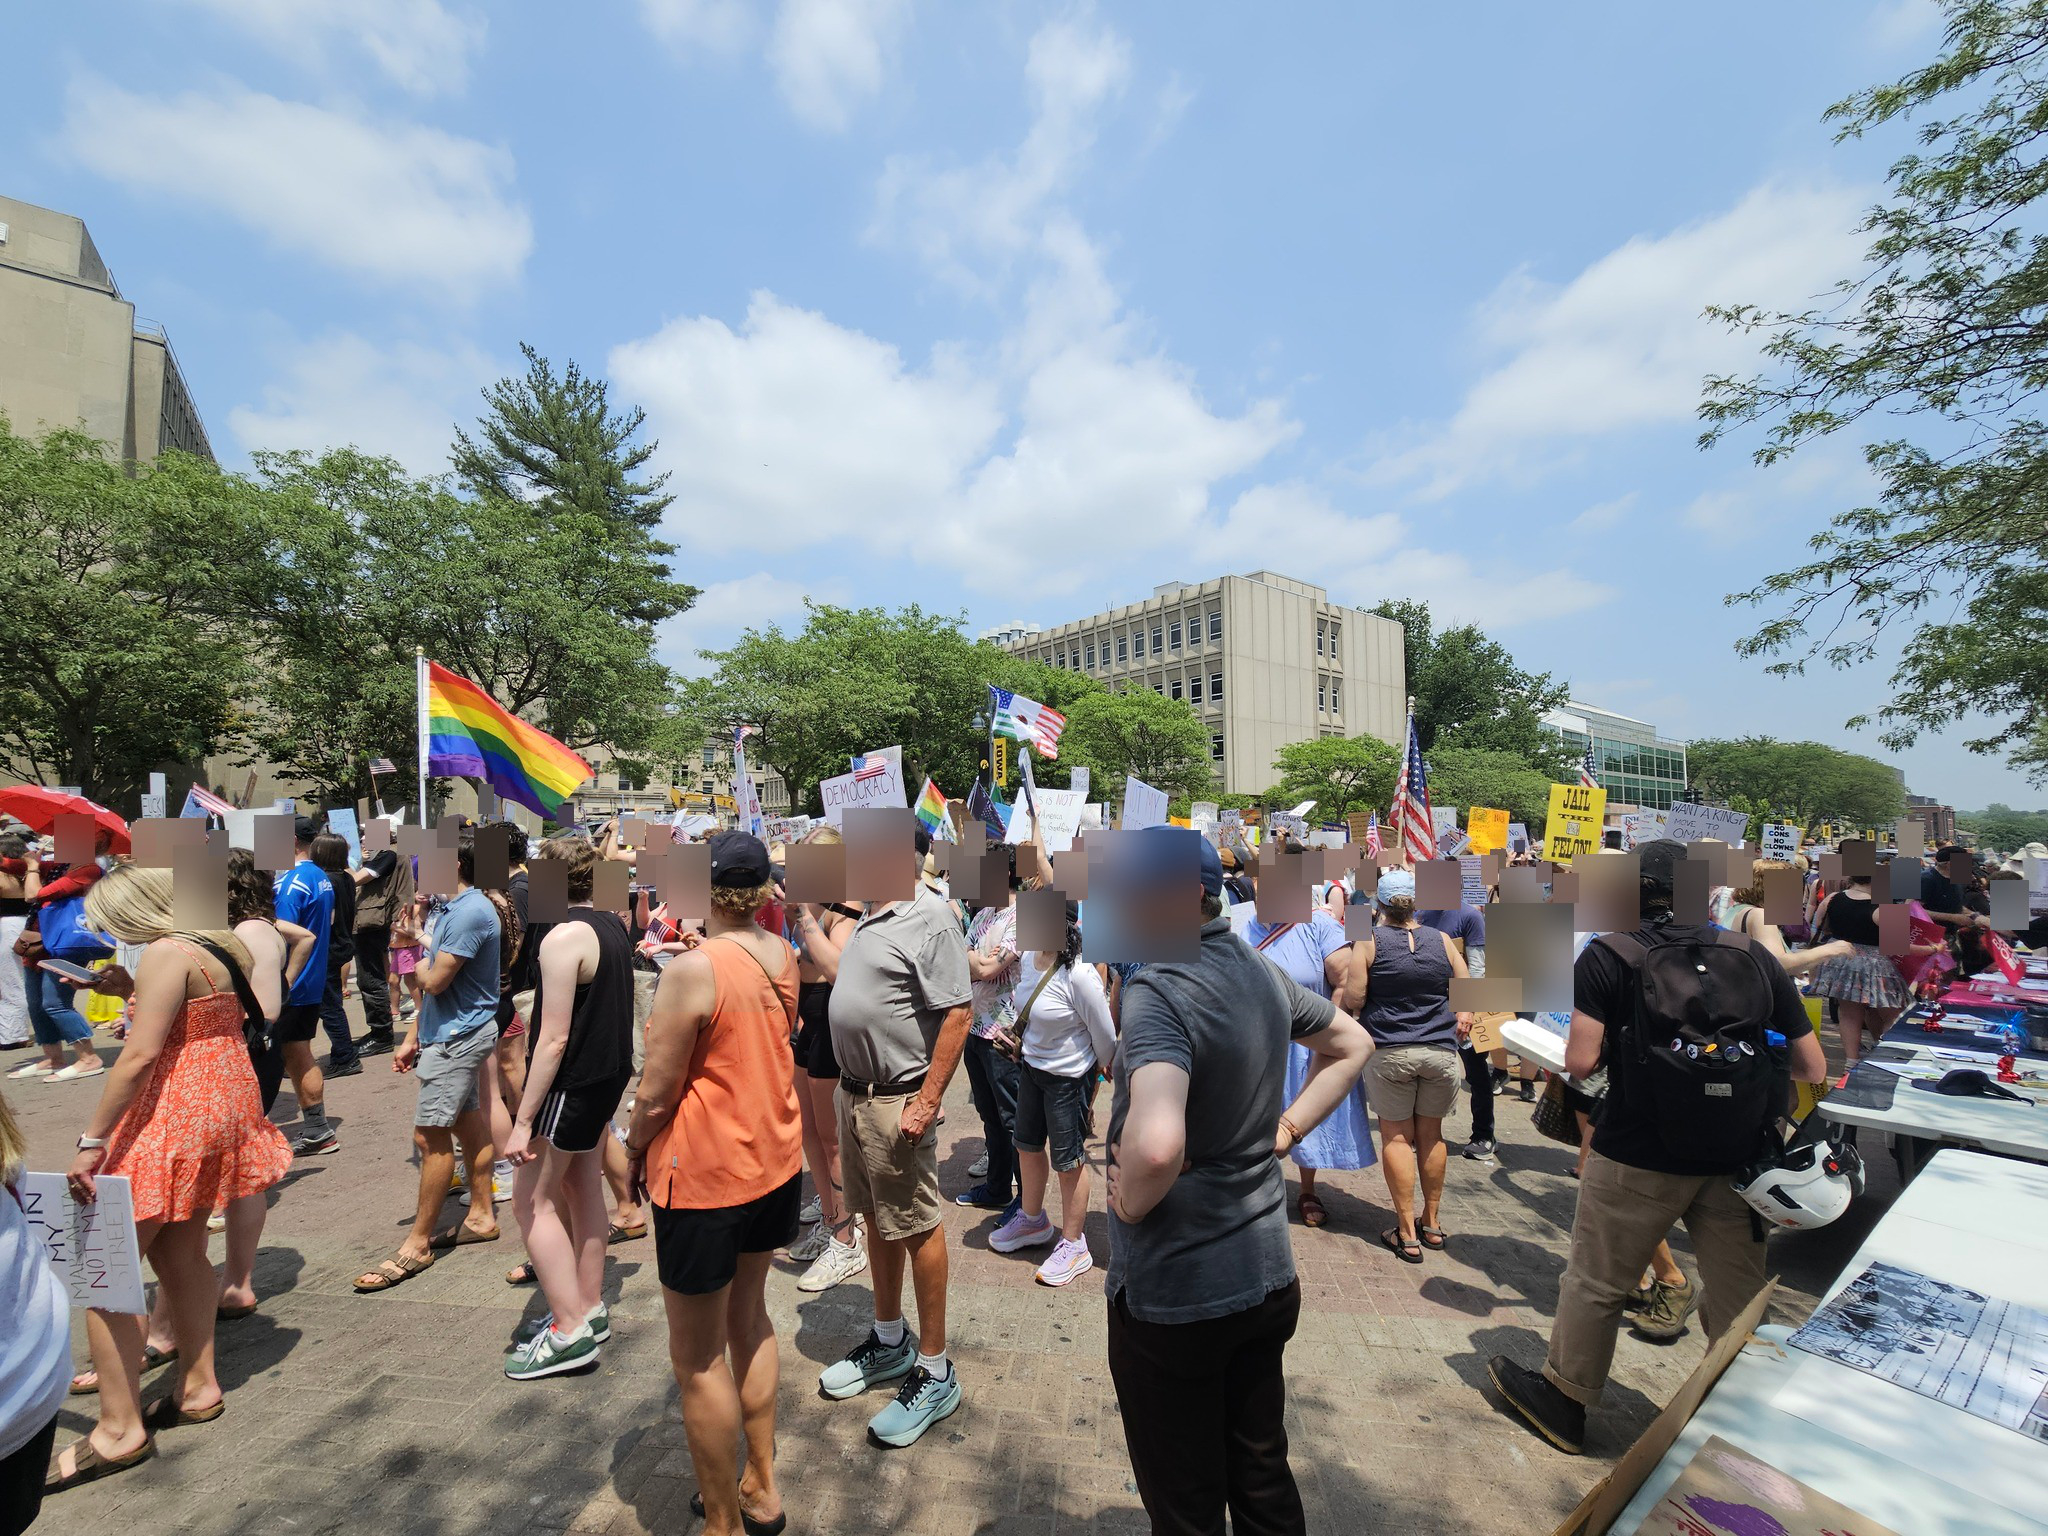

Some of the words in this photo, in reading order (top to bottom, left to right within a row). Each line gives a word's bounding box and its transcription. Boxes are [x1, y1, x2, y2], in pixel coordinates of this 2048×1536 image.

[825, 769, 897, 806] DEMOCRACY
[1056, 794, 1078, 806] NOT
[1562, 788, 1591, 812] JAIL
[1558, 813, 1594, 822] THE
[1671, 801, 1698, 818] WANT
[1700, 808, 1710, 820] A
[1712, 809, 1749, 826] KING?
[1674, 818, 1696, 828] MOVE
[1706, 822, 1720, 831] TO
[1672, 827, 1717, 840] OMAN
[1764, 843, 1795, 851] CLOWNS
[25, 1193, 45, 1224] IN
[46, 1223, 67, 1262] MY
[102, 1183, 130, 1287] STREETS
[84, 1243, 109, 1288] NOT
